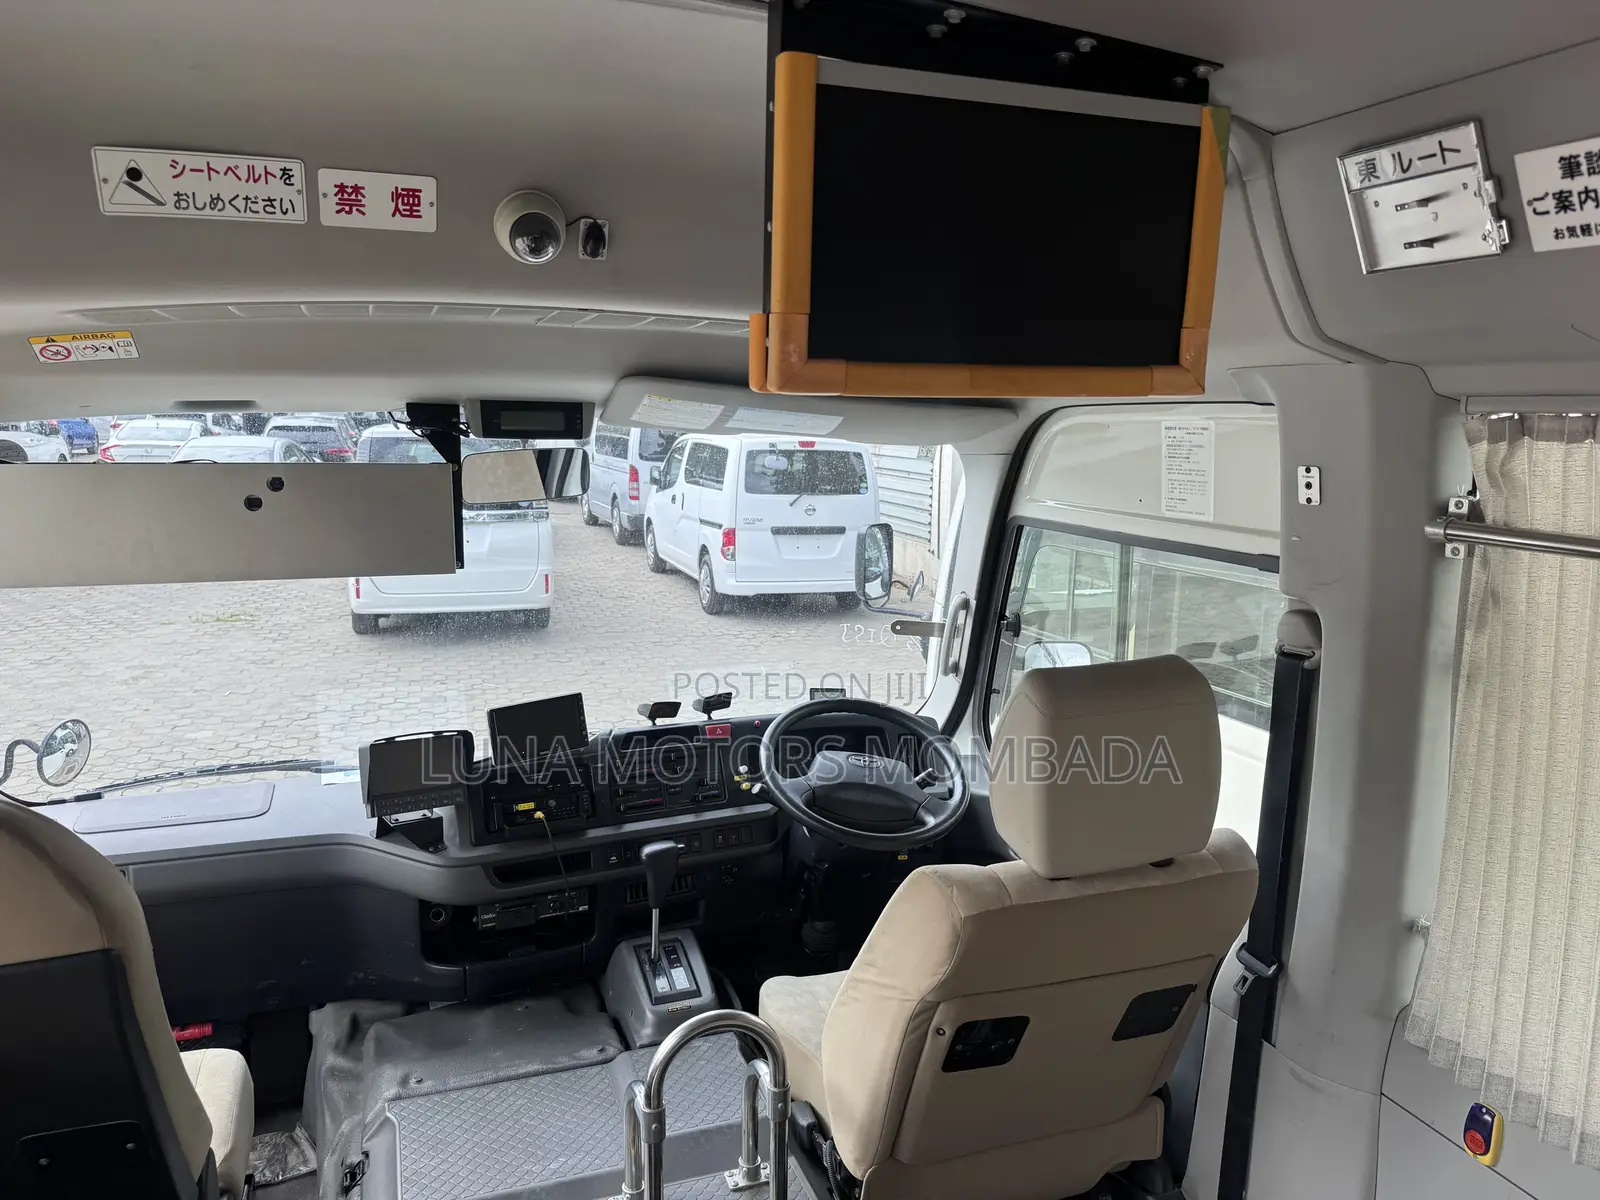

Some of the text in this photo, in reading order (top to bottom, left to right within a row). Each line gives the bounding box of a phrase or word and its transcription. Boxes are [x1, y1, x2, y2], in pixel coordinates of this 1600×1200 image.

[169, 159, 296, 187] シートベルトを
[1355, 140, 1461, 183] 東ルート
[173, 191, 296, 216] おしめください
[1532, 186, 1600, 216] ご案内
[71, 333, 116, 341] AIRBAG
